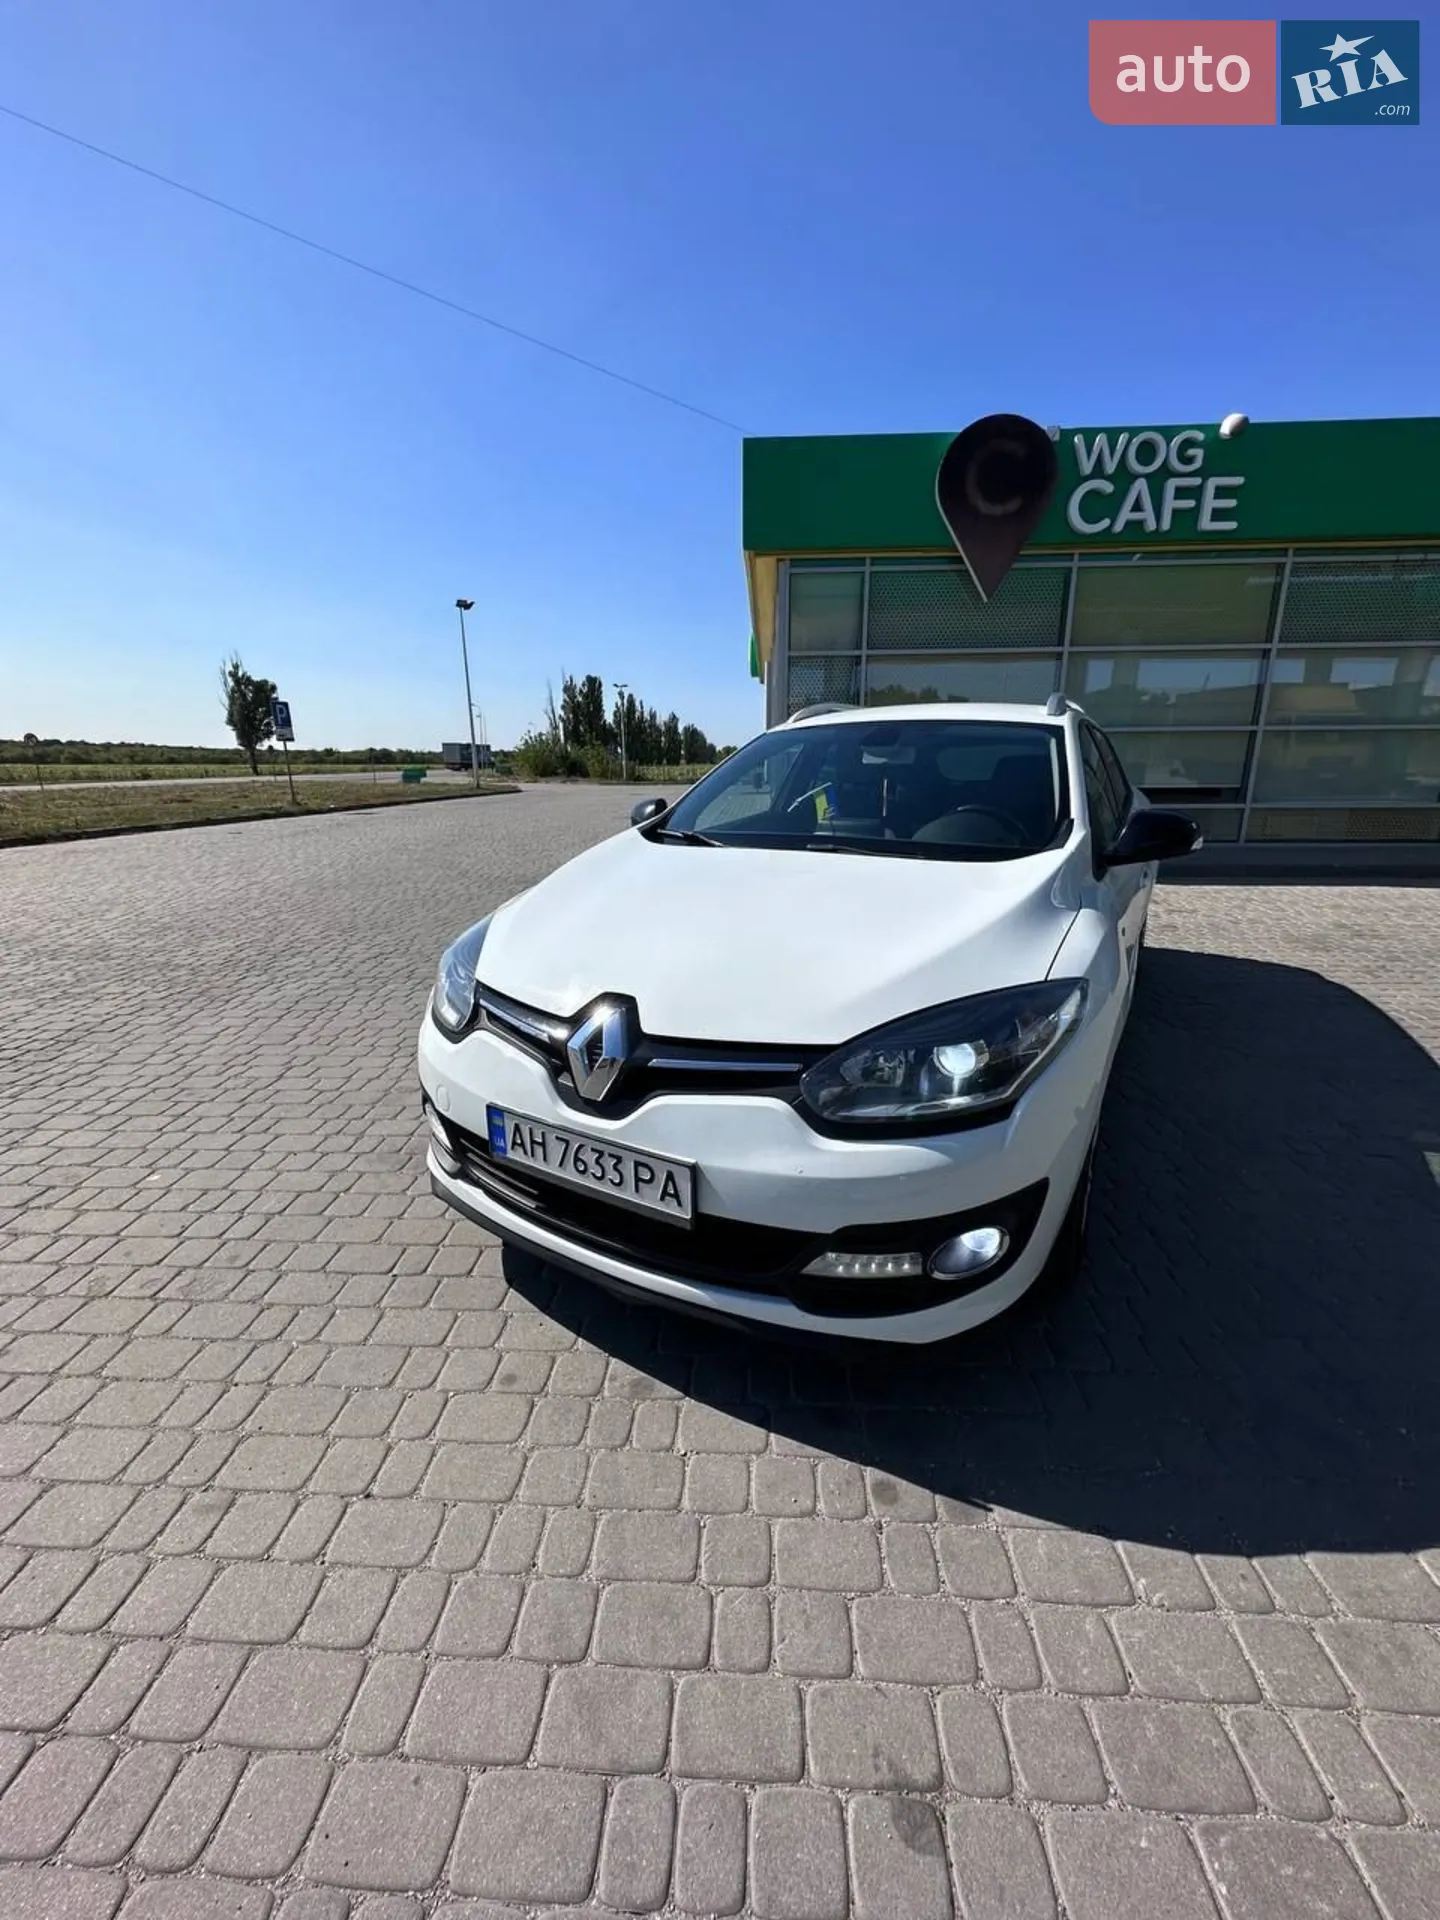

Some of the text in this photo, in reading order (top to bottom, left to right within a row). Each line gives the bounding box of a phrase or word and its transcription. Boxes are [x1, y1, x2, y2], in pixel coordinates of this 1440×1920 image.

[1074, 430, 1205, 476] WOG
[1067, 476, 1245, 534] CAFE
[275, 704, 287, 725] P
[510, 1122, 683, 1207] AH 7633 PA
